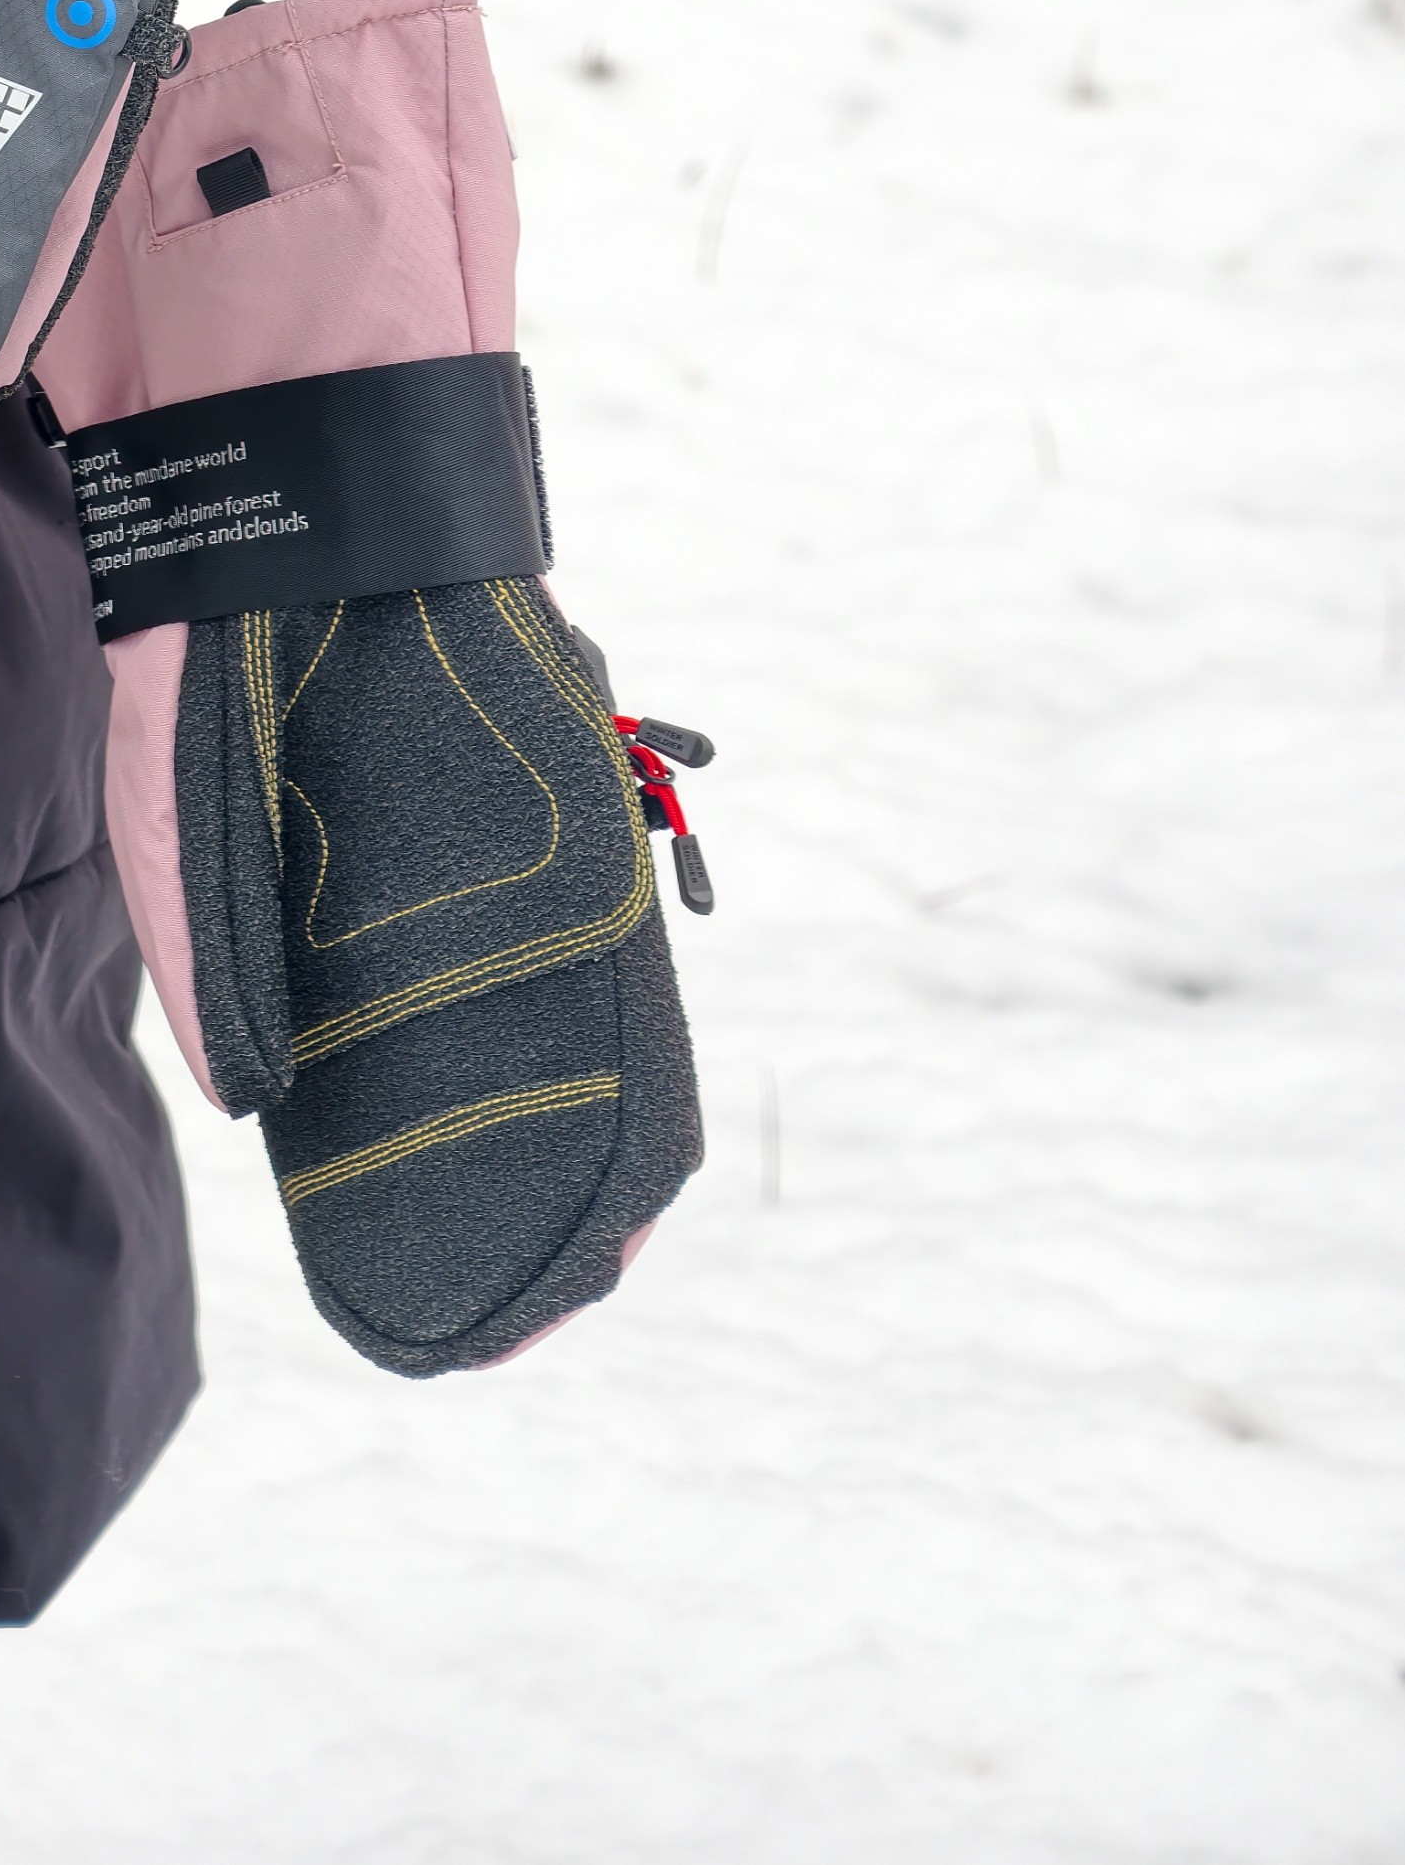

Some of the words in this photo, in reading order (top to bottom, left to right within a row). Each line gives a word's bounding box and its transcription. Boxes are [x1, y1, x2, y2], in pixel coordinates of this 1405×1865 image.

[102, 472, 133, 493] the
[194, 441, 247, 469] world
[85, 495, 152, 523] freedom
[190, 502, 223, 527] pine
[224, 490, 282, 517] forest
[134, 531, 204, 562] mountains
[208, 520, 243, 545] and
[244, 510, 309, 540] clouds
